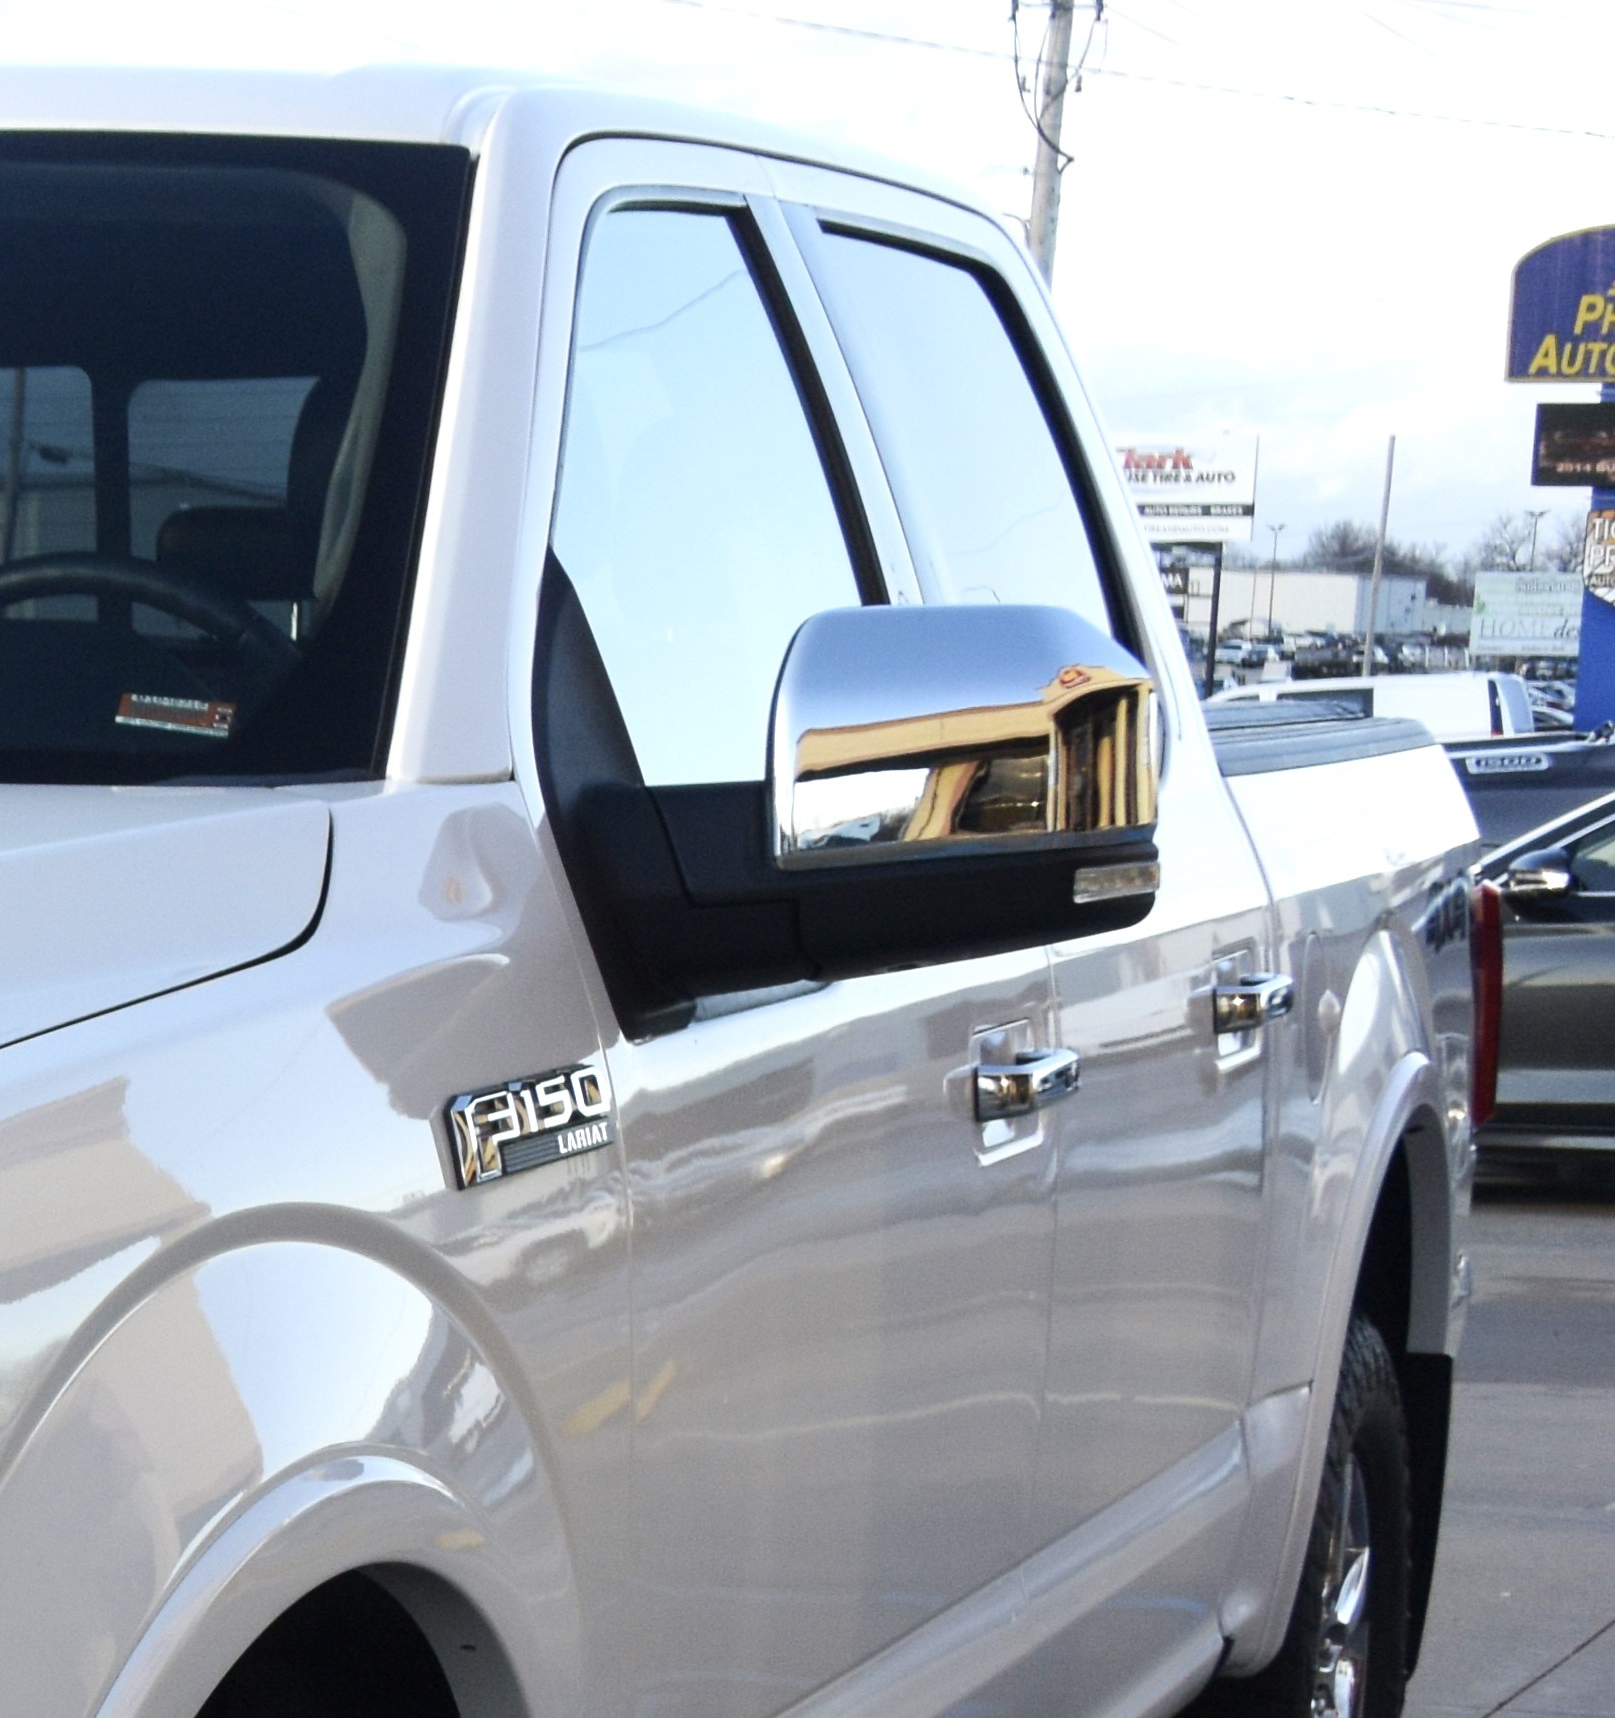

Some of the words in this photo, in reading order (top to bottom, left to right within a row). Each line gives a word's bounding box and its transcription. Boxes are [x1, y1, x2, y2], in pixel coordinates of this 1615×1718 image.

[1153, 471, 1180, 482] TIRE
[1195, 471, 1236, 482] AUTO
[557, 1122, 609, 1155] LARIAT
